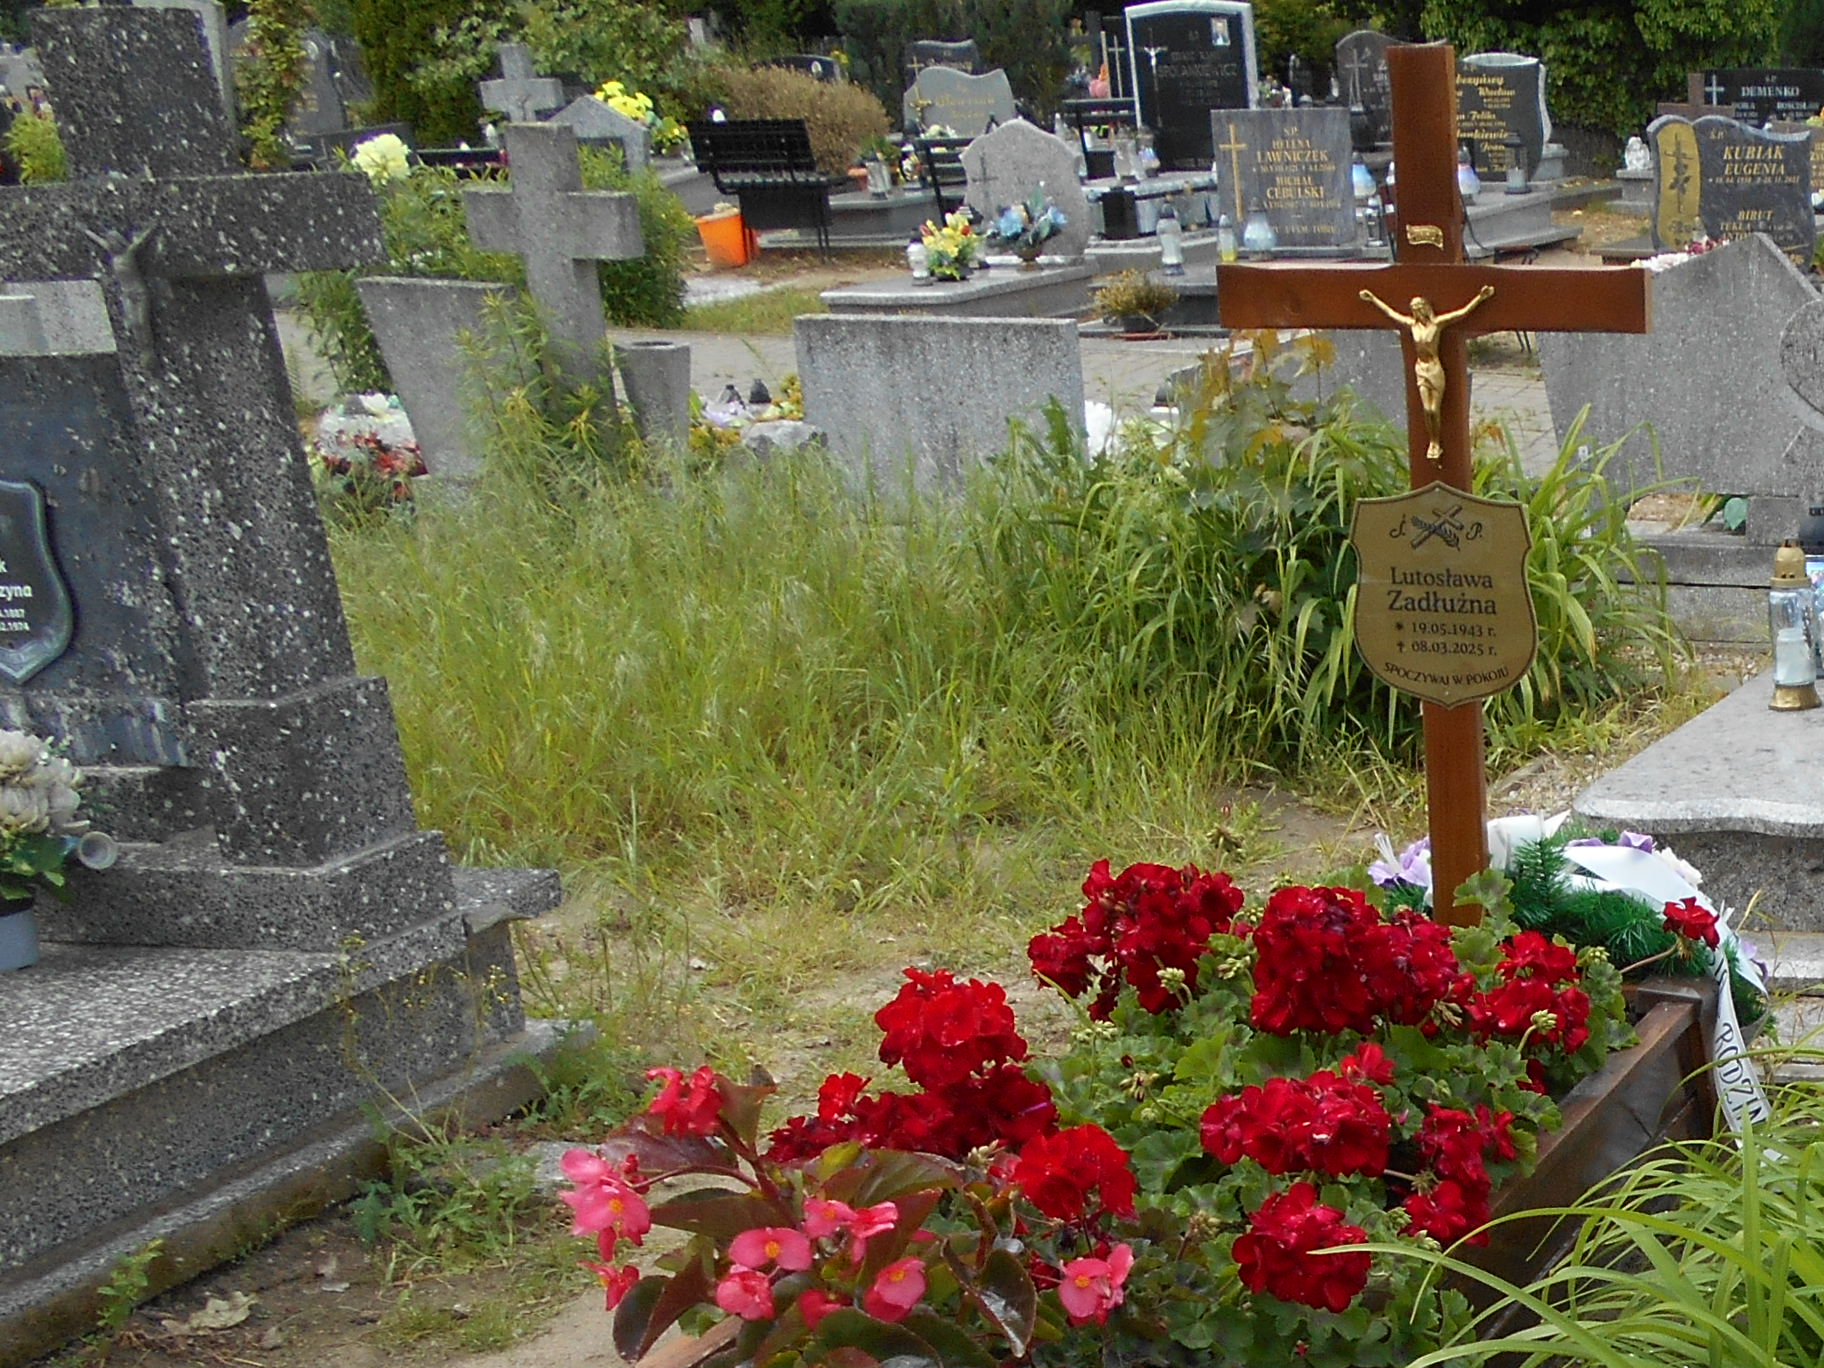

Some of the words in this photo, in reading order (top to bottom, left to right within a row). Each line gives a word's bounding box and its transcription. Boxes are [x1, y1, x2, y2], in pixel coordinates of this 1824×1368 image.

[1741, 86, 1801, 97] DEMENKO
[1723, 145, 1786, 161] KUBIAK
[1724, 162, 1786, 175] EUGENIA
[1389, 566, 1494, 590] Lutosława
[1386, 590, 1498, 616] Zadłużna
[1411, 621, 1484, 638] 19.05.1943
[1411, 640, 1485, 657] 08.03.2025
[1383, 661, 1450, 685] SPOCZYWAJ
[1452, 673, 1466, 686] W
[1466, 665, 1511, 686] POKOJU
